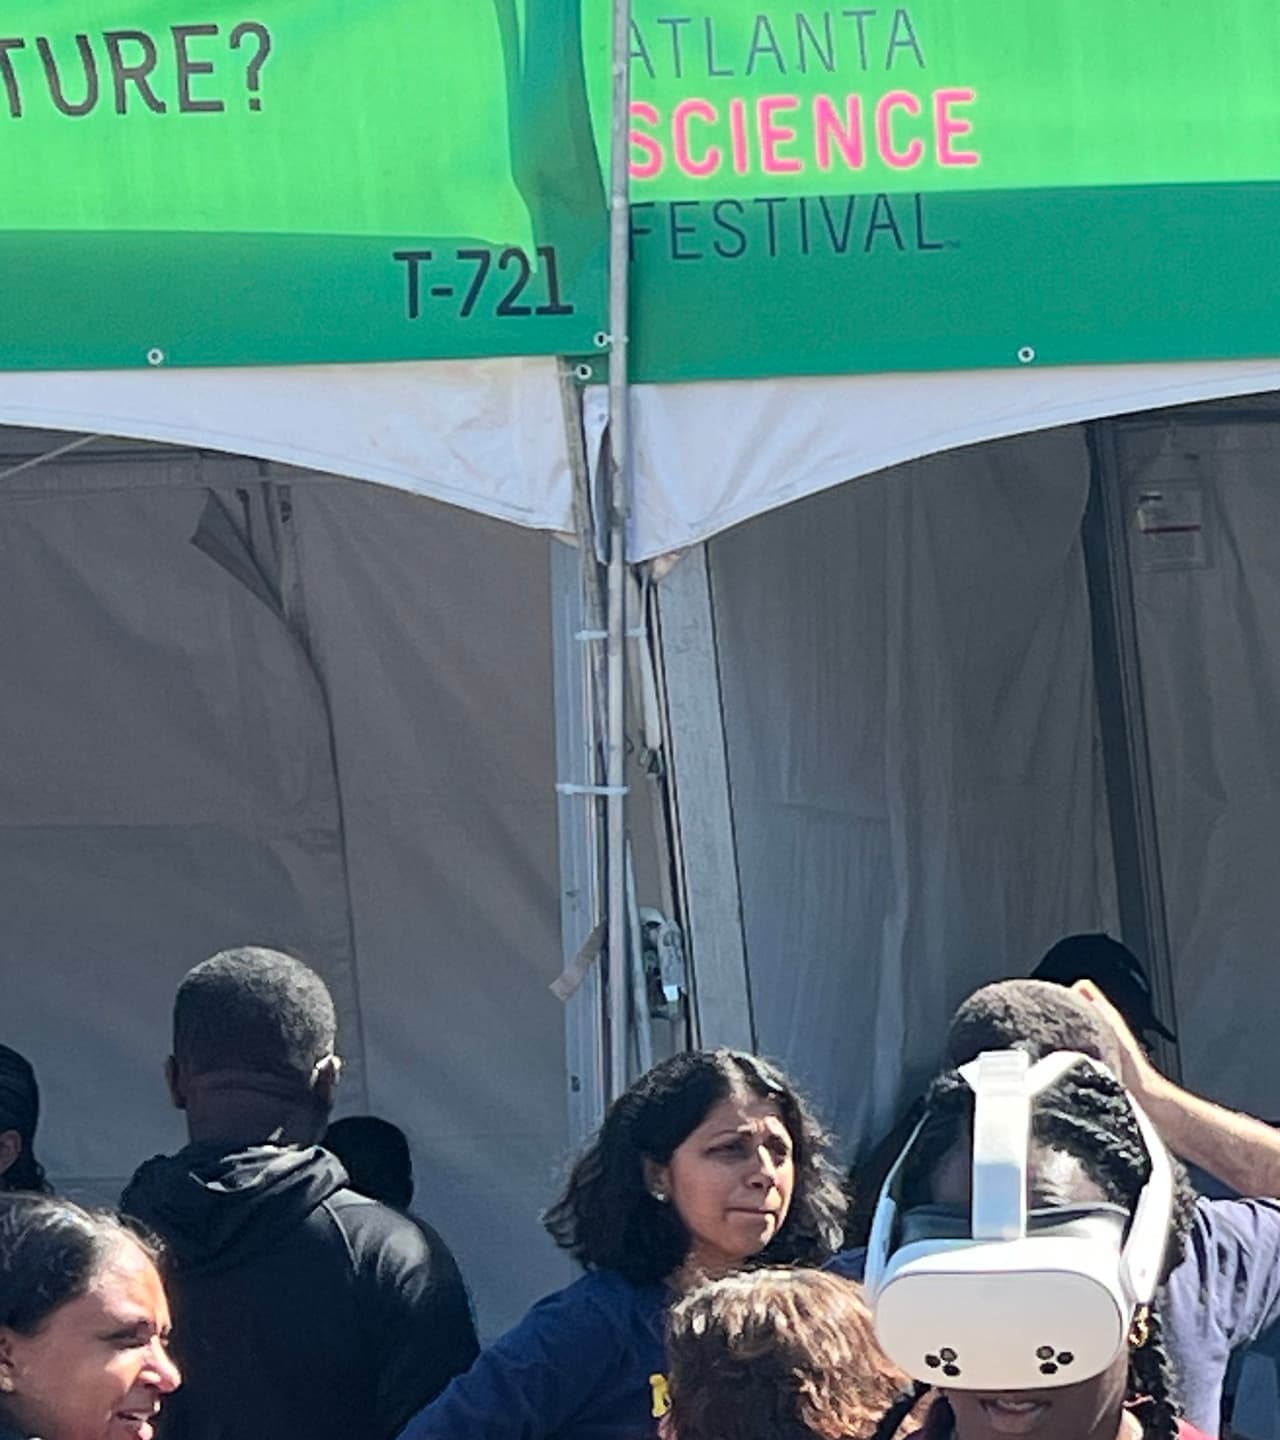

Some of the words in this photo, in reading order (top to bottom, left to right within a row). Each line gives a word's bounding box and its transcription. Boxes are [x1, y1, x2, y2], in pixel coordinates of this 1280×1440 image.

[627, 88, 979, 179] SCIENCE
[628, 192, 943, 262] FESTIVAL
[392, 245, 575, 319] T-721
